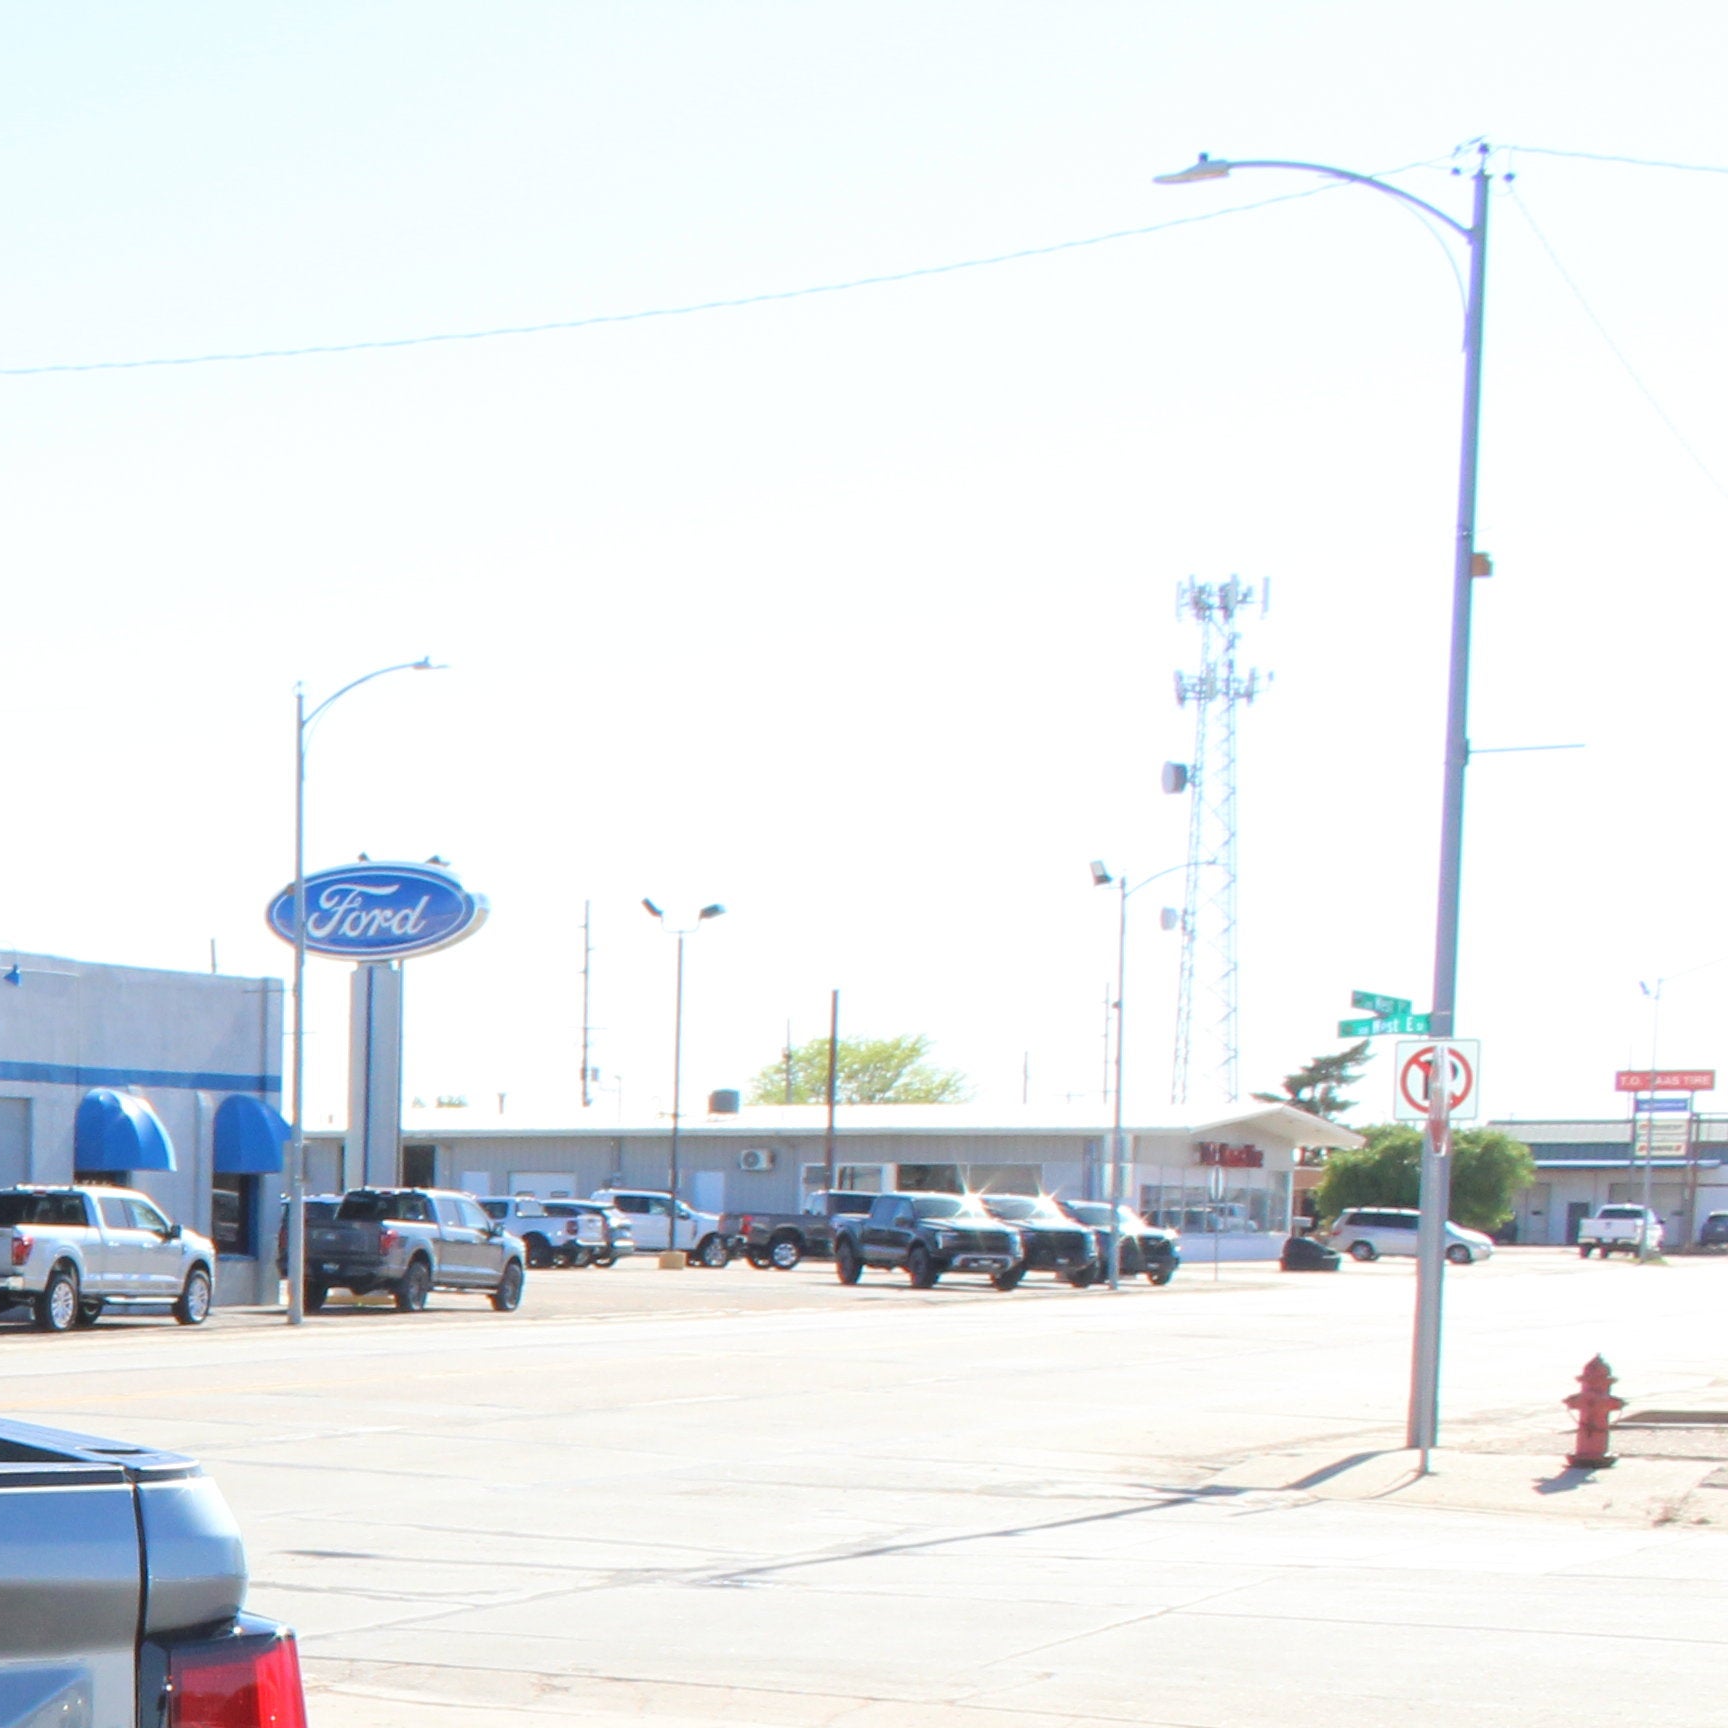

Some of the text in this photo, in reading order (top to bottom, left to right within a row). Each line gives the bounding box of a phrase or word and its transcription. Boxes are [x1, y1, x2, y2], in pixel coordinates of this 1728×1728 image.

[307, 884, 431, 938] Ford
[1406, 1016, 1414, 1032] E
[1684, 1074, 1712, 1086] TIRE
